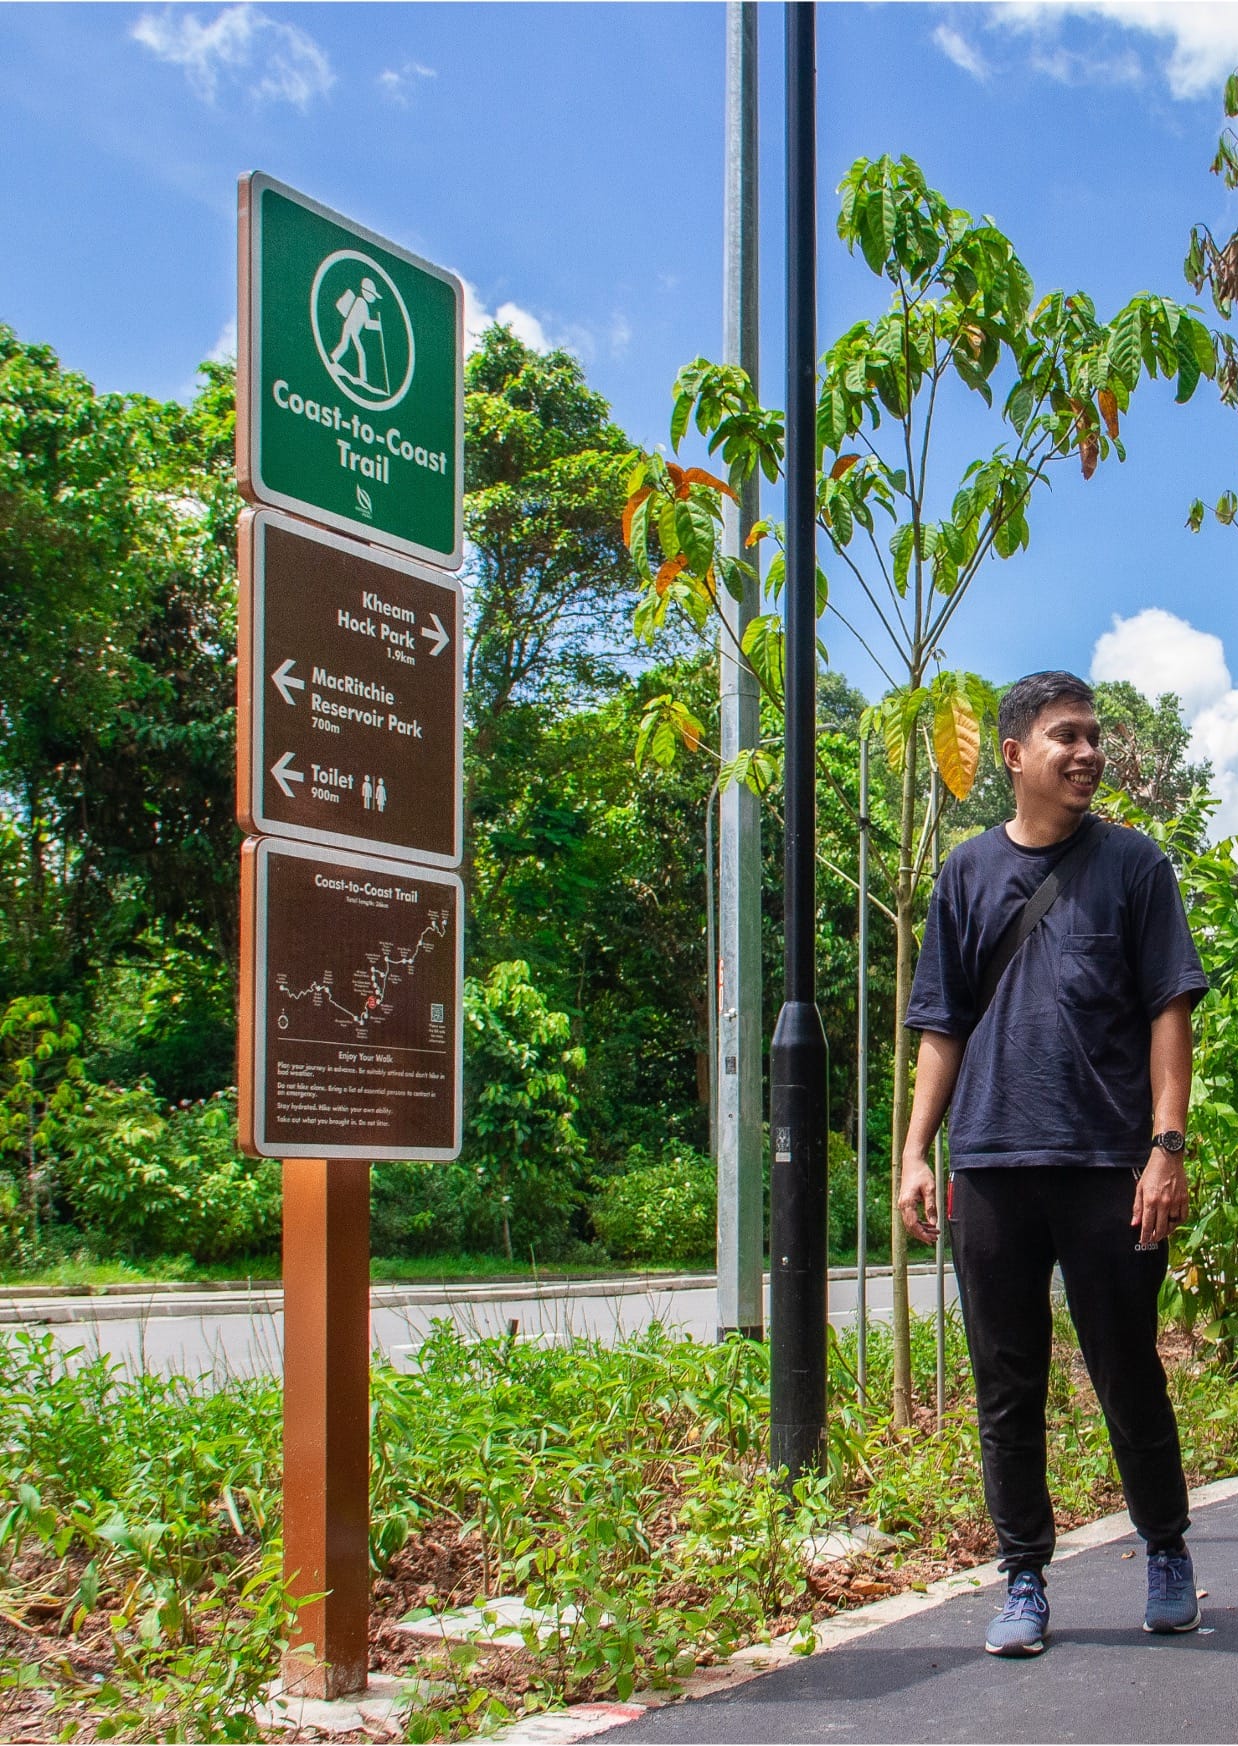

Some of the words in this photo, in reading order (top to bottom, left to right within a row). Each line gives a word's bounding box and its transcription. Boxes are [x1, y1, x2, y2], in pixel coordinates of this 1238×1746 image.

[272, 379, 447, 476] Coast-to-Coast
[336, 439, 389, 484] Trail
[362, 591, 415, 624] Kheam
[338, 609, 376, 638] Hock
[381, 624, 415, 650] Park
[386, 647, 416, 666] 1.9km
[312, 666, 394, 705] MacRitchie
[311, 693, 384, 729] Reservoir
[388, 718, 423, 739] Park
[311, 716, 340, 734] 700m
[311, 764, 353, 790] Toilet
[311, 786, 340, 804] 900m
[315, 874, 393, 899] Coast-to-Coast
[395, 888, 417, 903] Trail
[338, 1051, 357, 1062] Enjoy
[359, 1053, 374, 1062] Your
[376, 1054, 393, 1063] Walk
